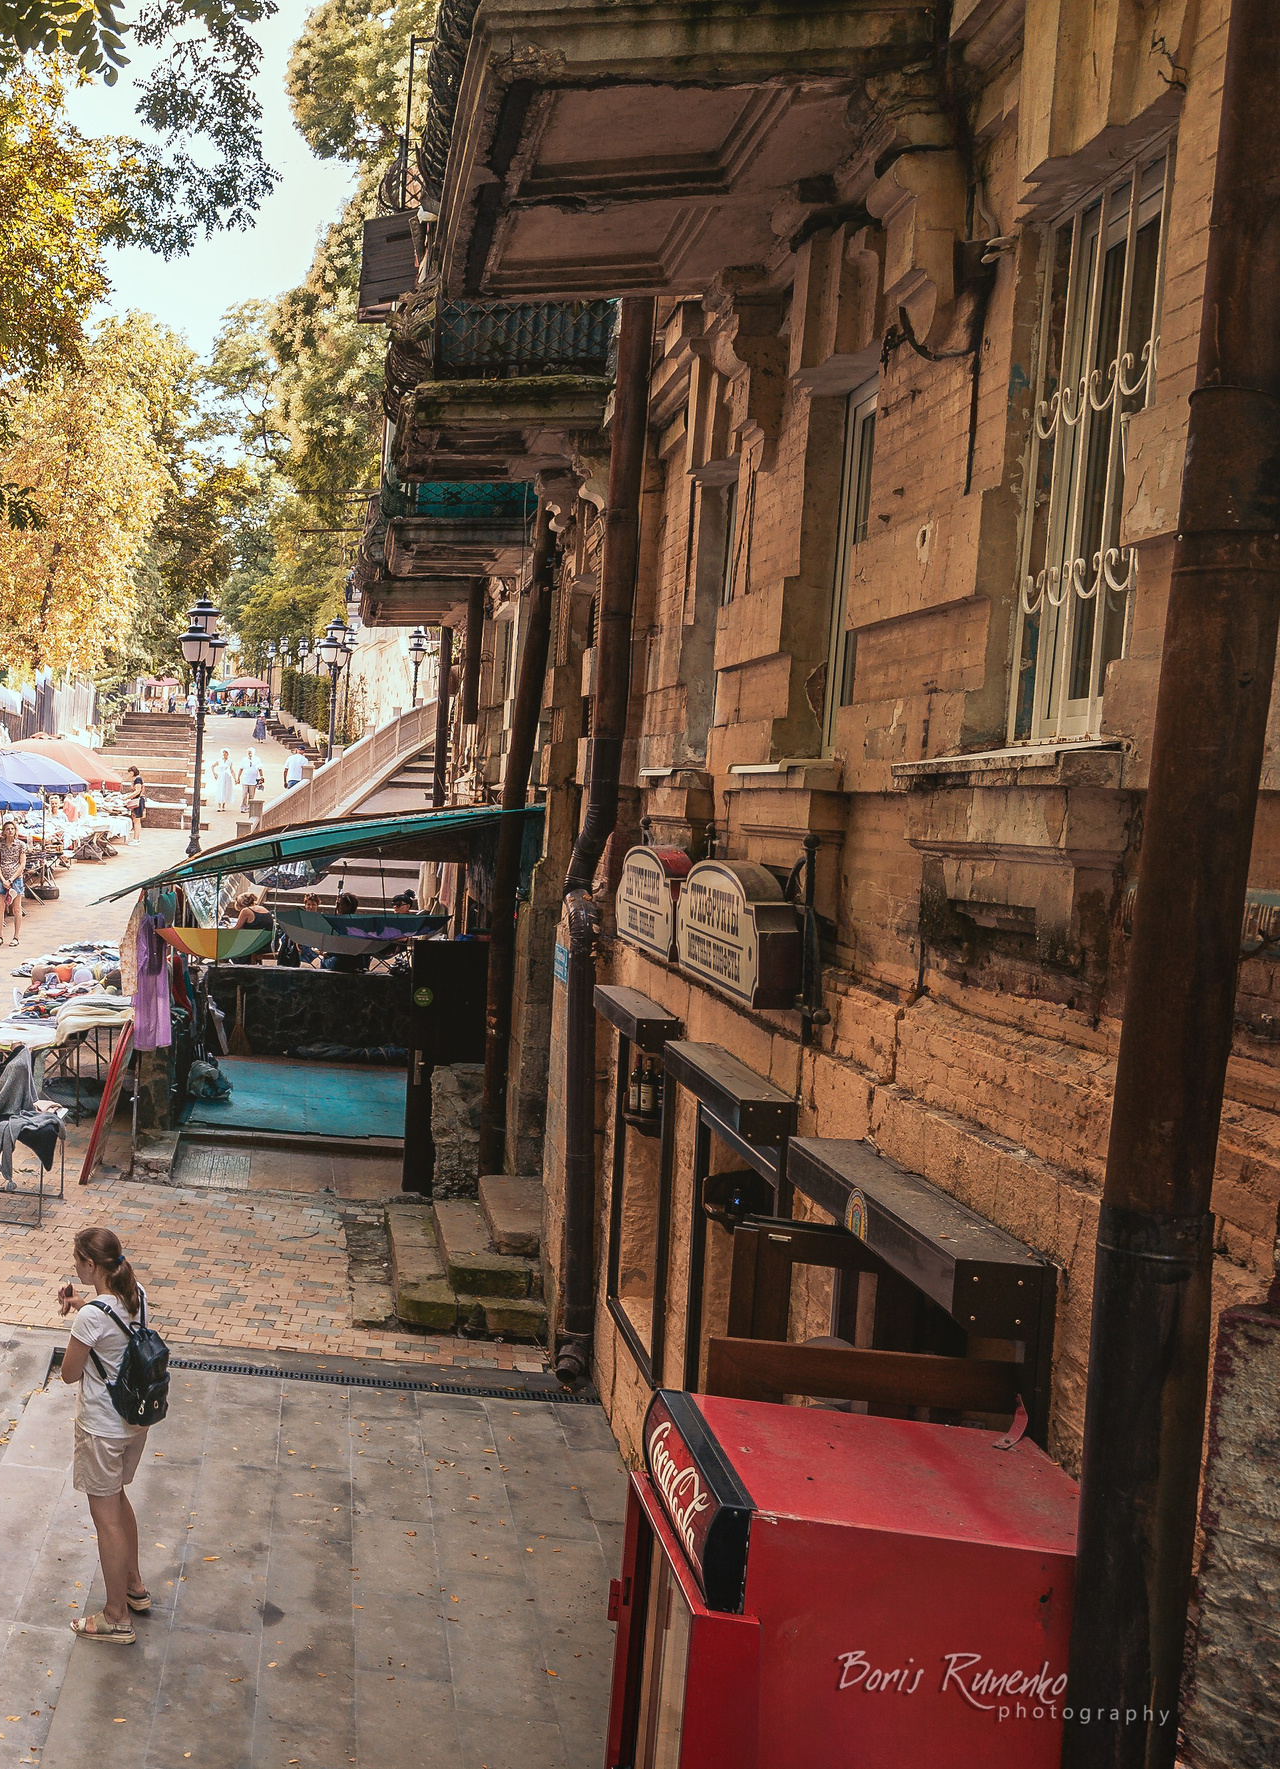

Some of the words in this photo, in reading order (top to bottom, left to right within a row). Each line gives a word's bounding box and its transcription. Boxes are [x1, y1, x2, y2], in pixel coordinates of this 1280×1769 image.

[690, 882, 739, 937] СУХОФРУКТЫ
[712, 942, 740, 983] КОНФЕТЫ
[649, 1421, 711, 1568] Coca-Cola
